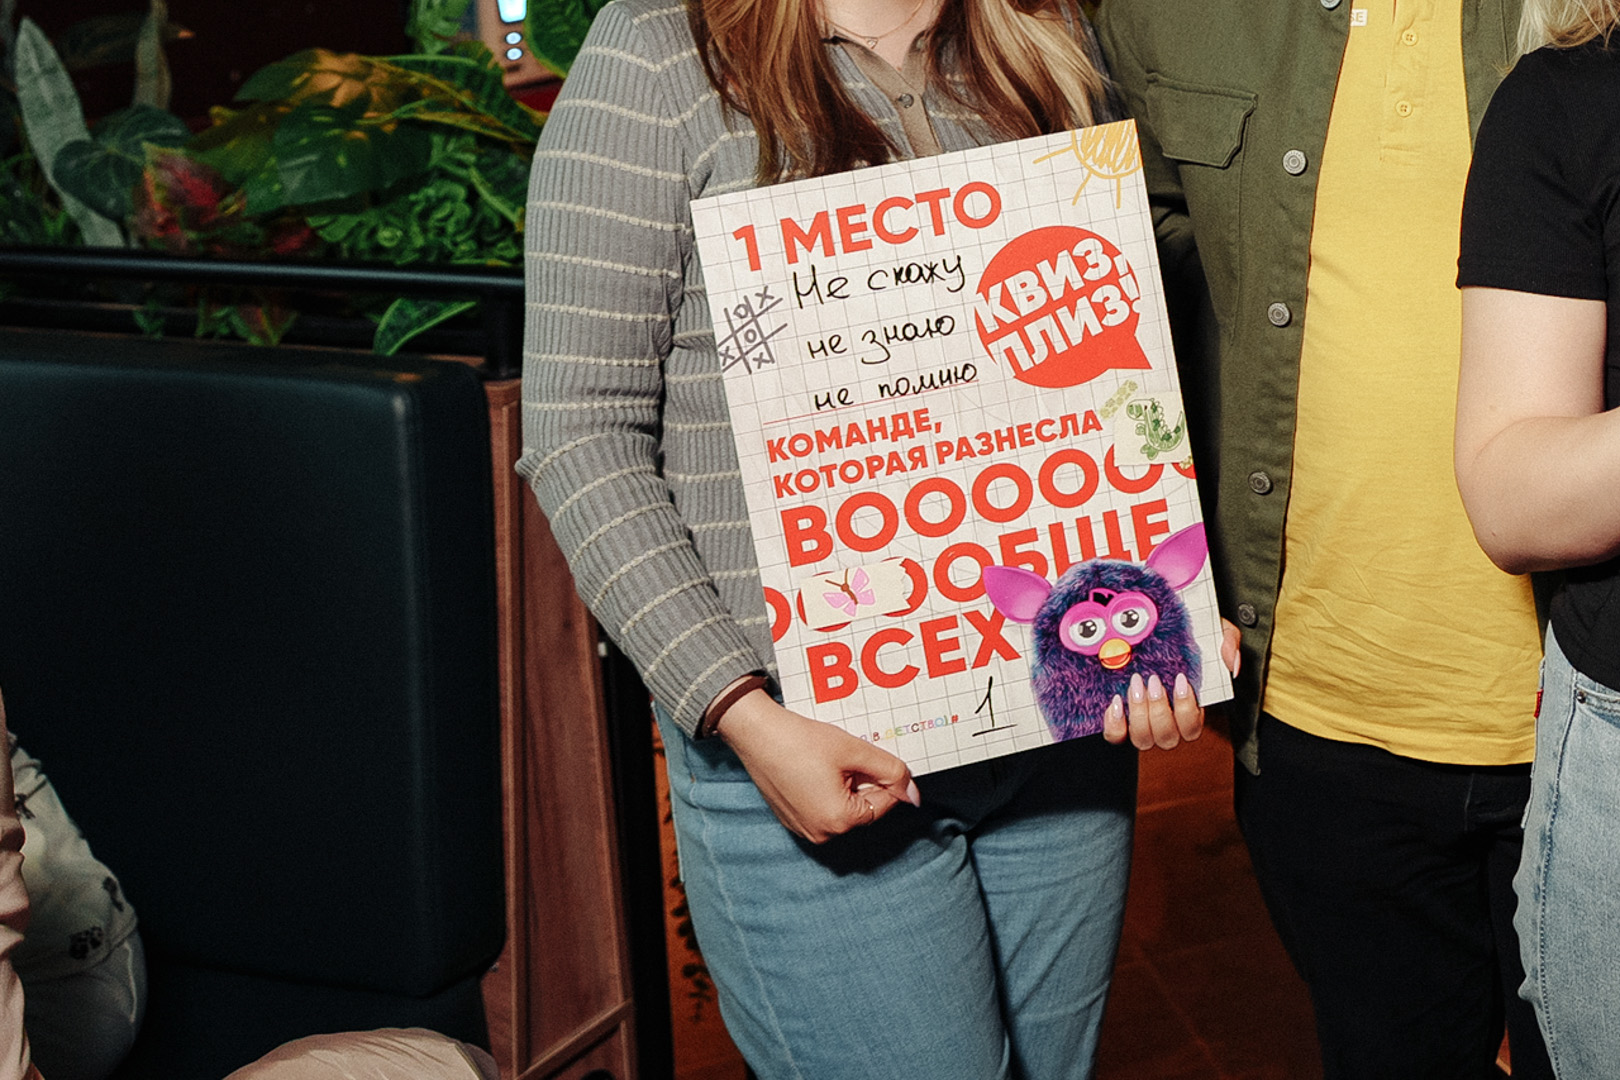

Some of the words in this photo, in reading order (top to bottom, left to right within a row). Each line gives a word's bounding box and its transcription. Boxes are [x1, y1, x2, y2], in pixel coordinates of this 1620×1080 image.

[732, 224, 762, 272] 1
[780, 181, 1001, 264] МЕСТО
[867, 255, 965, 292] скажу
[807, 334, 848, 359] не
[861, 315, 955, 364] знаю
[987, 273, 1141, 376] ПЛИЗ!
[814, 388, 854, 410] не
[878, 363, 977, 397] помню
[766, 408, 942, 463] КОМАНДЕ,
[773, 449, 928, 499] КОТОРАЯ
[937, 410, 1103, 465] РАЗНЕСЛА
[806, 606, 1021, 704] ВСЕХ
